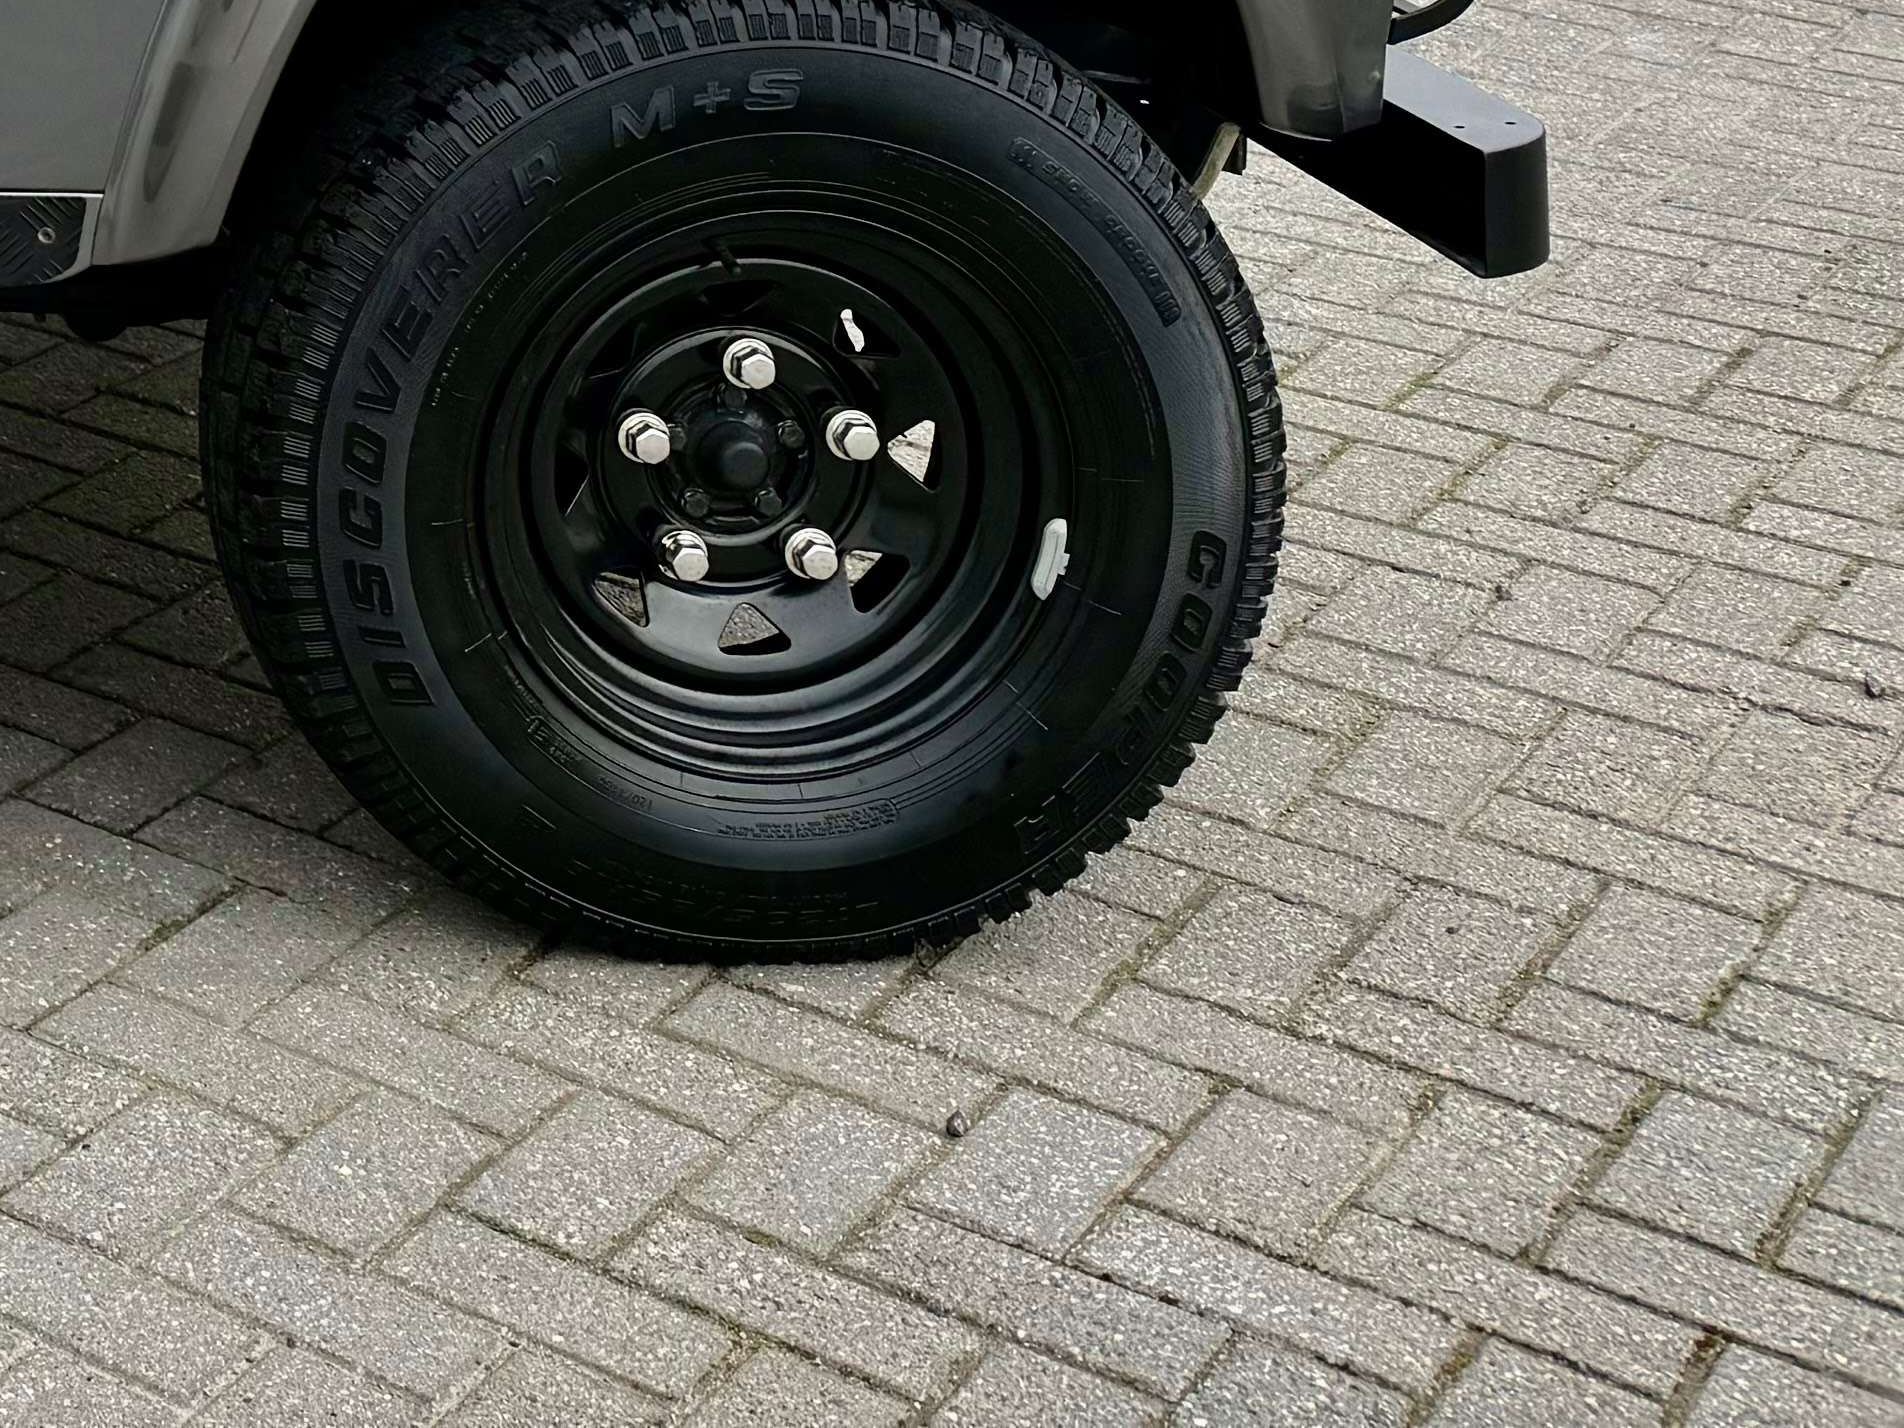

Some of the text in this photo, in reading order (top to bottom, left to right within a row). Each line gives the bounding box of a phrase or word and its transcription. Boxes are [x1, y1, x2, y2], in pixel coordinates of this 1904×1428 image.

[338, 139, 563, 706] DISCOVERER
[608, 68, 806, 149] M+S
[1014, 532, 1228, 855] COOPER
